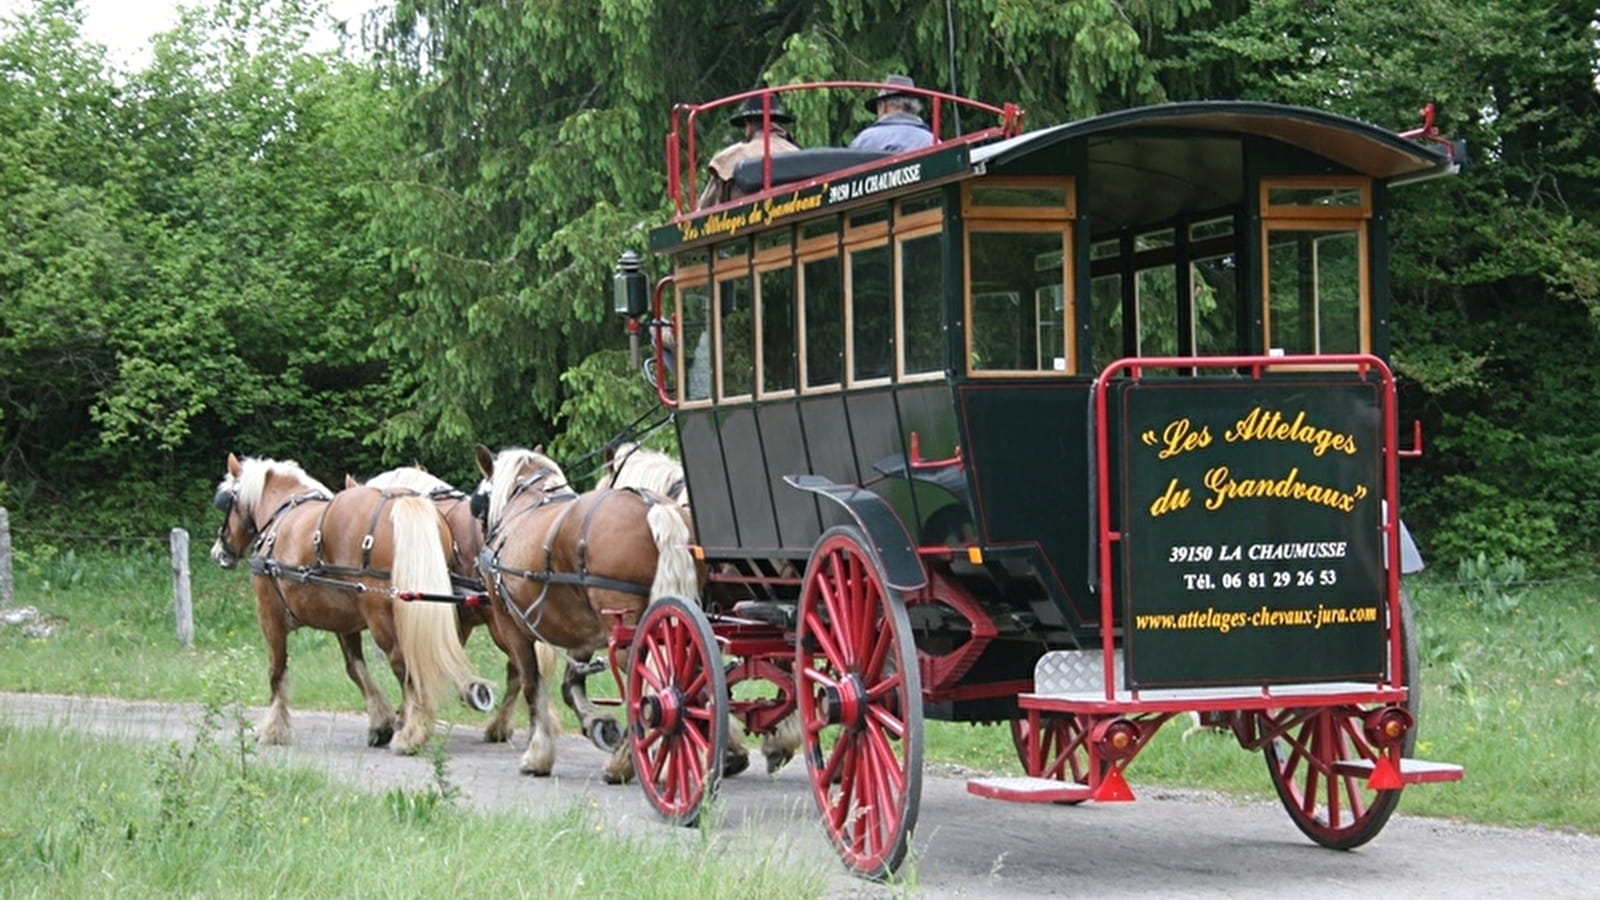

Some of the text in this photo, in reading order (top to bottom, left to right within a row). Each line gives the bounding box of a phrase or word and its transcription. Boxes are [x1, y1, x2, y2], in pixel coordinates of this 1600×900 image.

[748, 202, 763, 225] du
[851, 180, 864, 198] LA
[864, 163, 921, 194] CHAUMUSSE
[1224, 407, 1357, 456] Attelages
[1150, 478, 1192, 517] du
[1168, 542, 1347, 563] 39150 LA CHAUMUSSE
[1183, 570, 1337, 590] Tél. 06 81 29 26 53
[1136, 604, 1377, 633] www.attelages-chevaux-jura.com
